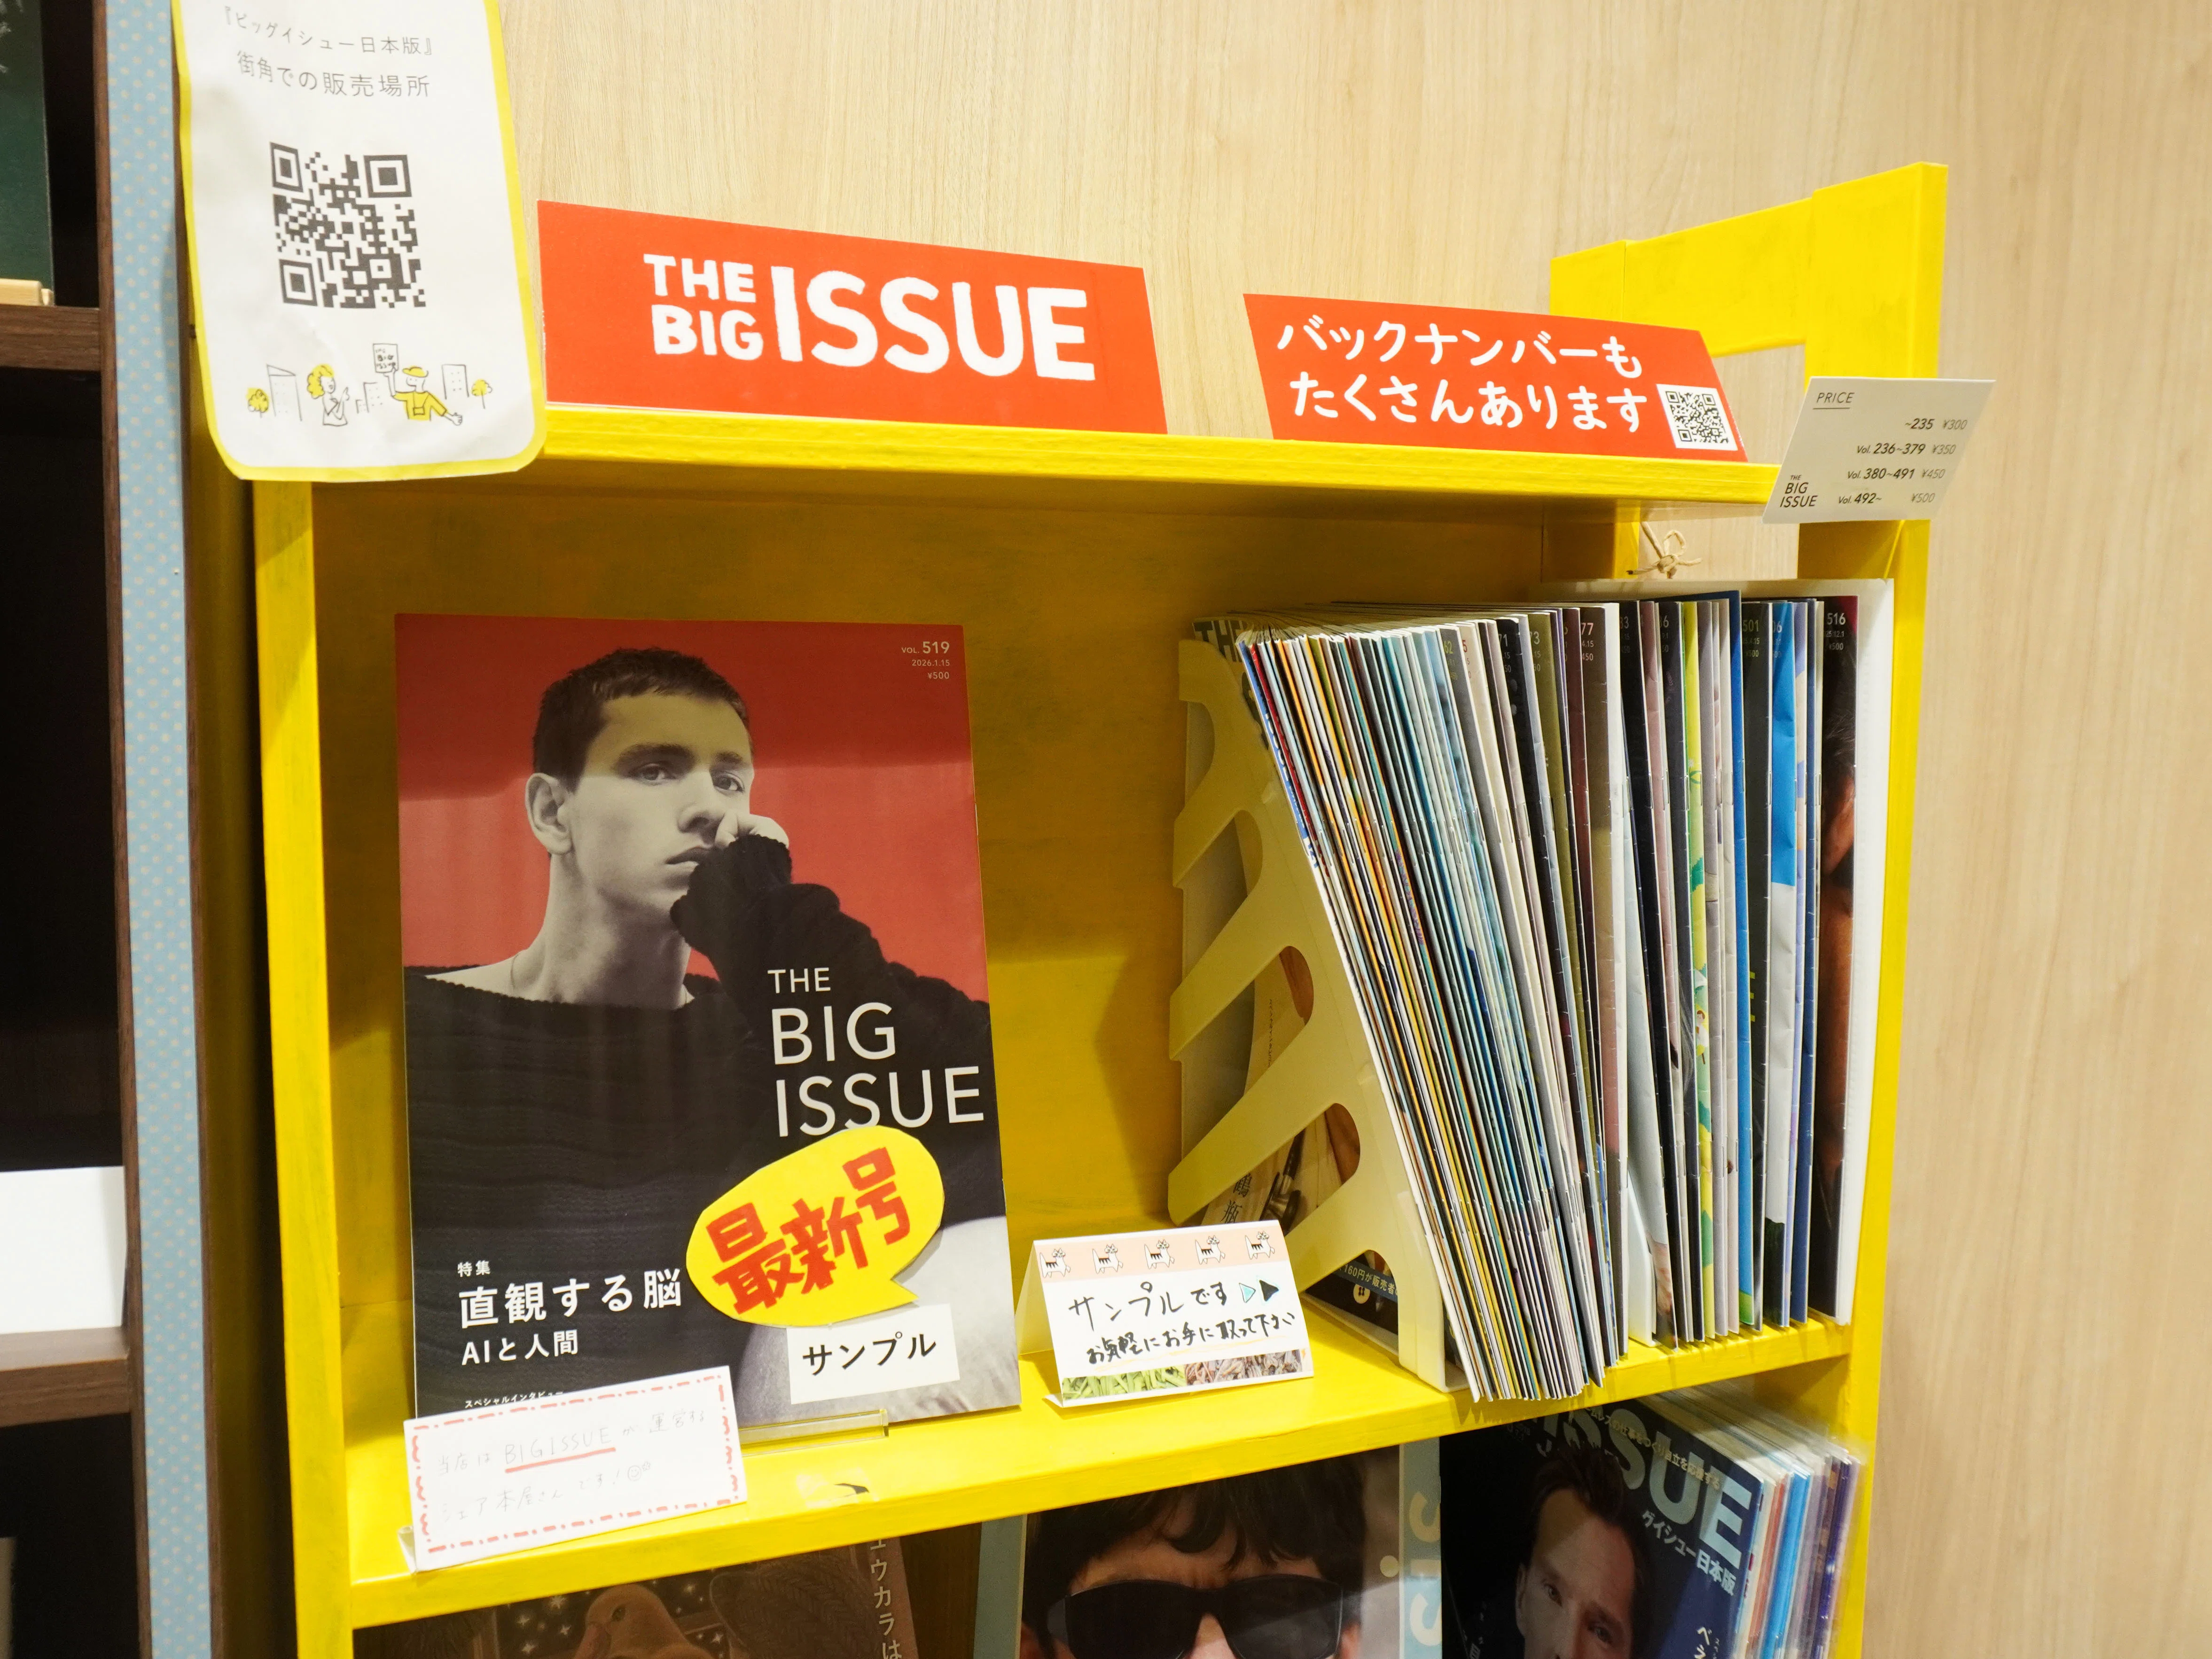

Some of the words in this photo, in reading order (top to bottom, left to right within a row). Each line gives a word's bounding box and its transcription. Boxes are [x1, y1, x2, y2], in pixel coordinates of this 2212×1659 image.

[236, 50, 430, 97] 街角での販売場所
[643, 254, 756, 302] THE
[651, 304, 764, 361] BIG
[770, 266, 1096, 381] ISSUE
[1277, 313, 1643, 379] バックナンバーも
[1289, 371, 1648, 433] たくさんあります
[1816, 392, 1855, 404] PRICE
[1943, 419, 1968, 430] ¥300
[1857, 445, 1872, 454] Vol.
[1932, 444, 1956, 454] ¥350
[1785, 482, 1809, 494] BIG
[1848, 470, 1861, 479] Vol.
[1921, 469, 1946, 479] ¥450
[1780, 495, 1818, 508] ISSUE
[1838, 495, 1852, 504] Vol.
[1911, 493, 1936, 503] ¥500
[1743, 619, 1759, 632] 501
[1827, 612, 1846, 625] 516
[922, 641, 950, 654] 519
[767, 967, 831, 994] THE
[772, 1002, 896, 1064] BIG
[776, 1065, 984, 1137] ISSUE
[705, 1147, 911, 1315] 最新号
[457, 1260, 491, 1277] 特集
[459, 1268, 681, 1329] 直観する脳
[1068, 1281, 1228, 1331] サンプルです
[461, 1329, 579, 1365] AIと人間
[802, 1331, 937, 1376] サンプル
